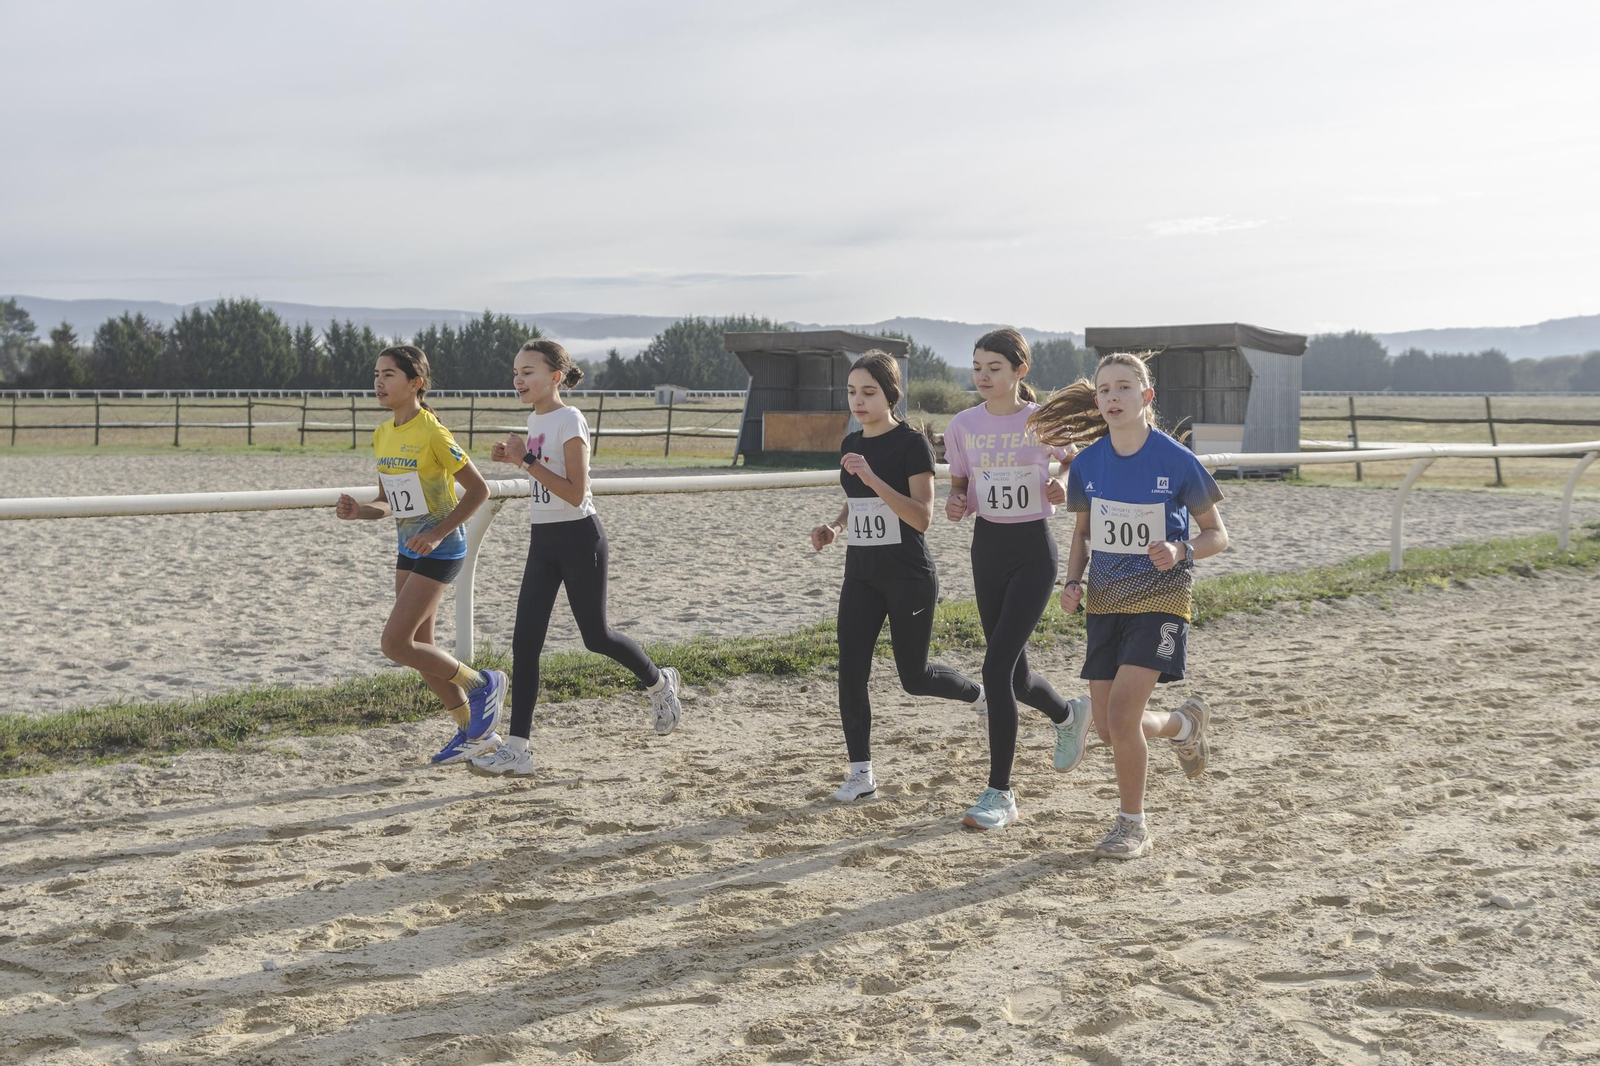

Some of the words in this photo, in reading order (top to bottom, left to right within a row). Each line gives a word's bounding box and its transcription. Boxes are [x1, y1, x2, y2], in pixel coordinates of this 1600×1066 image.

[987, 484, 1029, 510] 450
[854, 514, 886, 539] 449
[1104, 520, 1150, 548] 309
